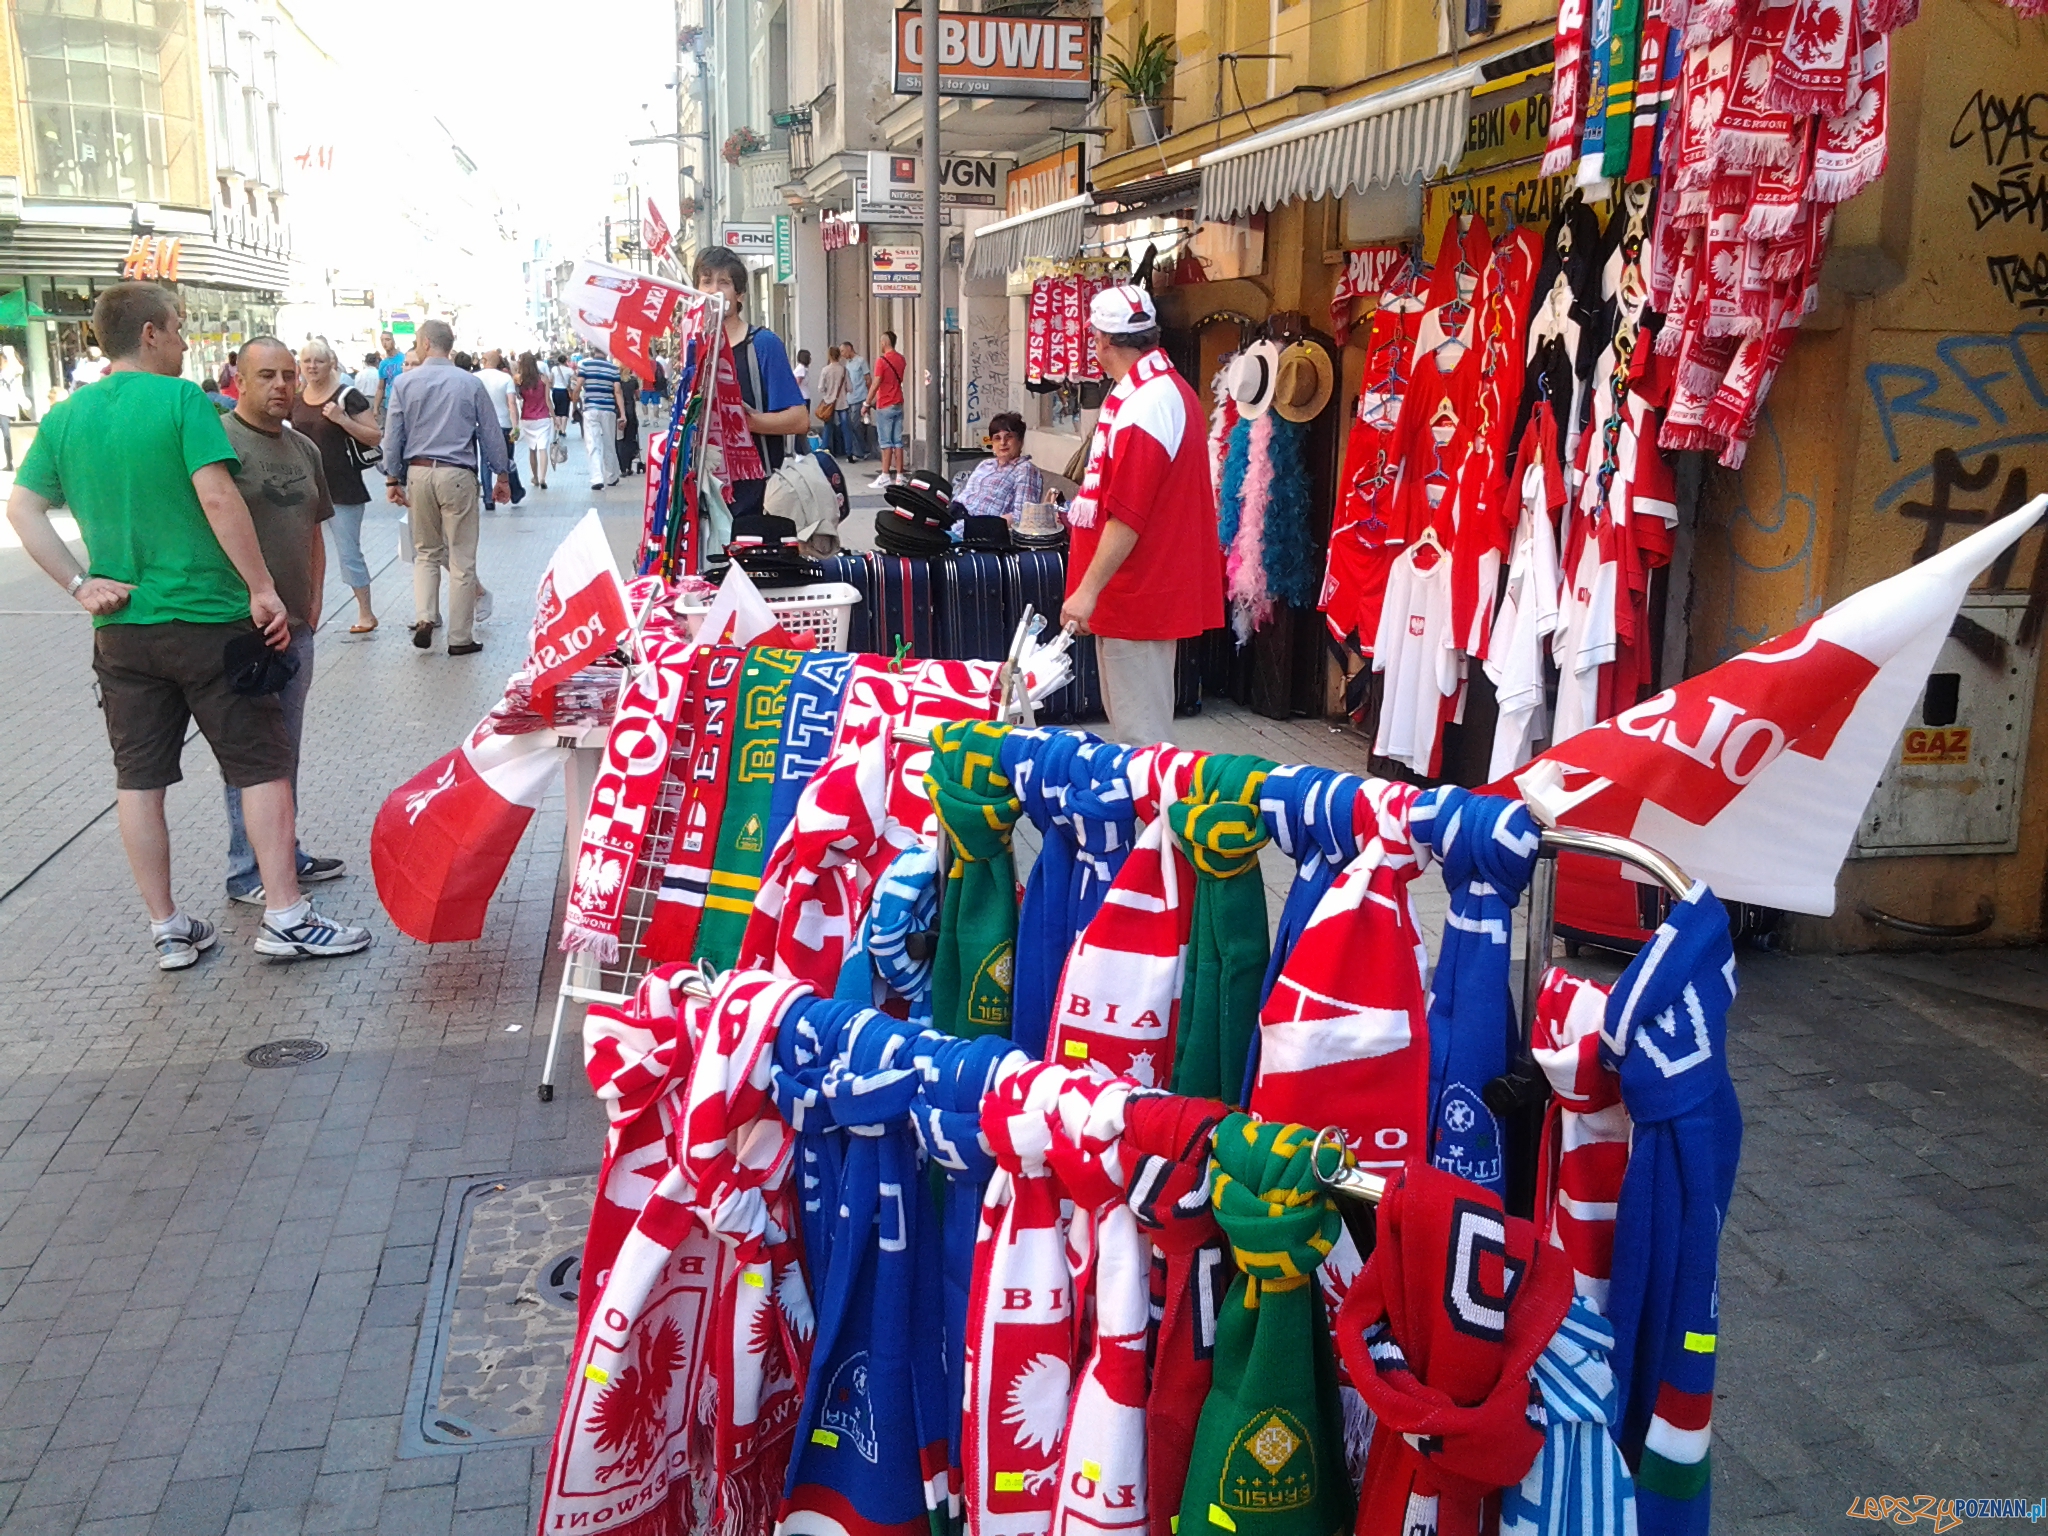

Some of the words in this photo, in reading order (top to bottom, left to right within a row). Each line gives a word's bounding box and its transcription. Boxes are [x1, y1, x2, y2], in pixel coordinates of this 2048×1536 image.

[904, 17, 1084, 70] OBUWIE
[947, 79, 964, 90] for
[967, 81, 990, 93] you
[1722, 116, 1788, 129] CZERWONI
[1816, 140, 1883, 167] CZERWONI
[778, 218, 791, 275] FUJIFILM
[1905, 730, 1967, 754] GAZ
